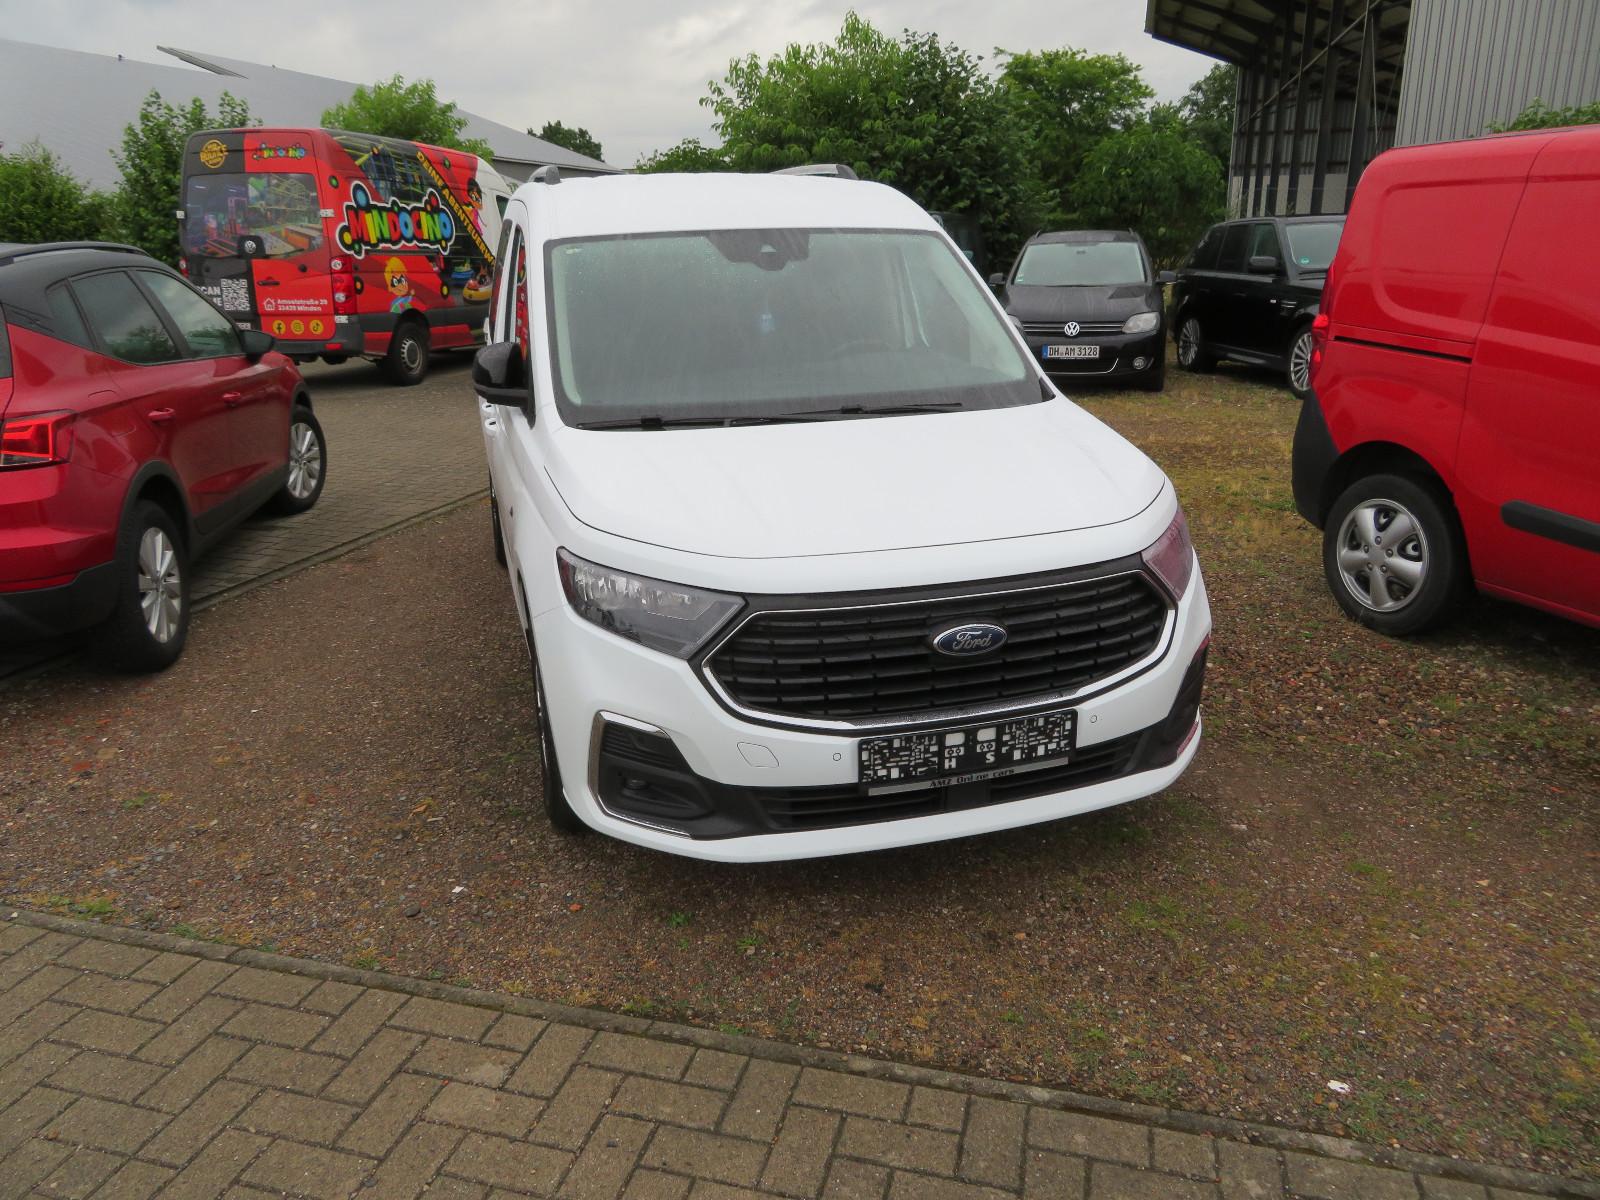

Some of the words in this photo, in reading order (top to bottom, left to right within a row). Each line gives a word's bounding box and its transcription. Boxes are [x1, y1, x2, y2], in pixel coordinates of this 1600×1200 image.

[416, 151, 444, 188] DEINE
[346, 206, 455, 245] MINDOCINO
[1049, 346, 1060, 356] DH
[1064, 346, 1076, 356] AM
[1077, 346, 1098, 356] 3128
[952, 630, 992, 650] Ford
